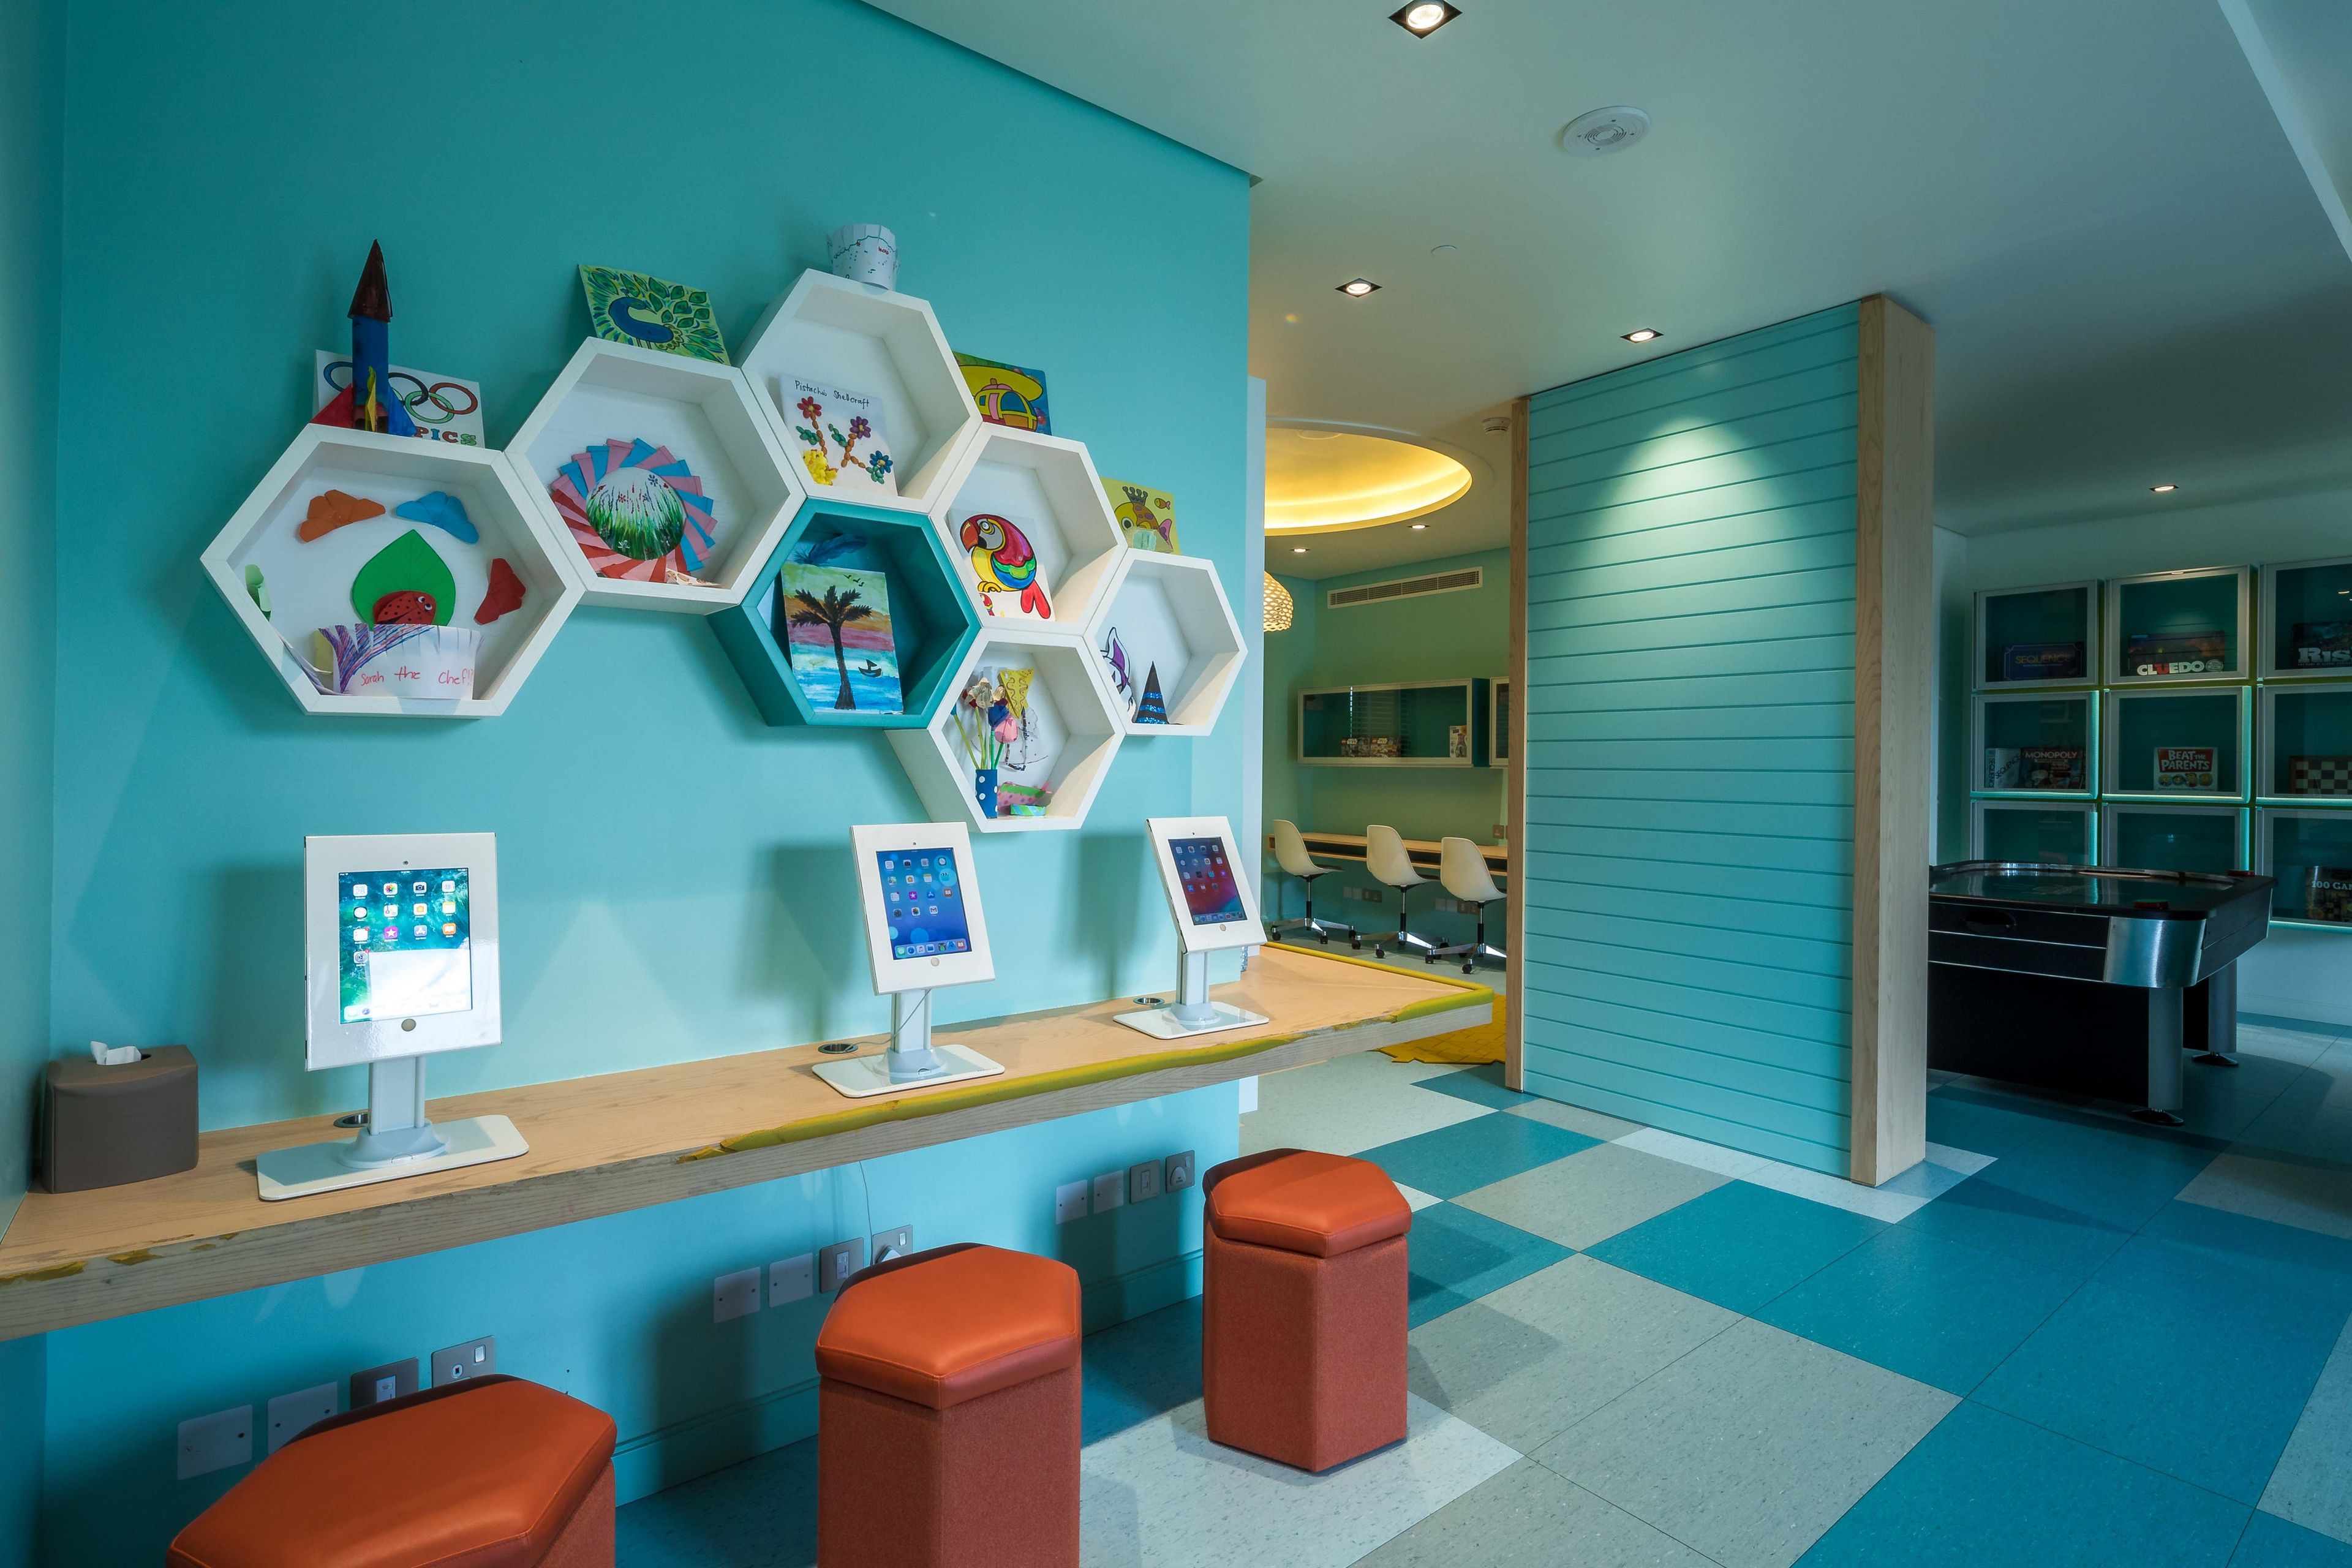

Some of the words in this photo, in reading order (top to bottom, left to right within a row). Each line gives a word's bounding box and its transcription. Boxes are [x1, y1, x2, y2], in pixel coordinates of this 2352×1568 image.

[2298, 647, 2352, 663] RIS
[2136, 660, 2204, 676] CLUEDO
[361, 671, 384, 686] Sarah
[394, 666, 420, 681] the
[2168, 750, 2196, 760] BEAT
[2161, 760, 2211, 771] PARENTS
[2312, 880, 2330, 889] 100
